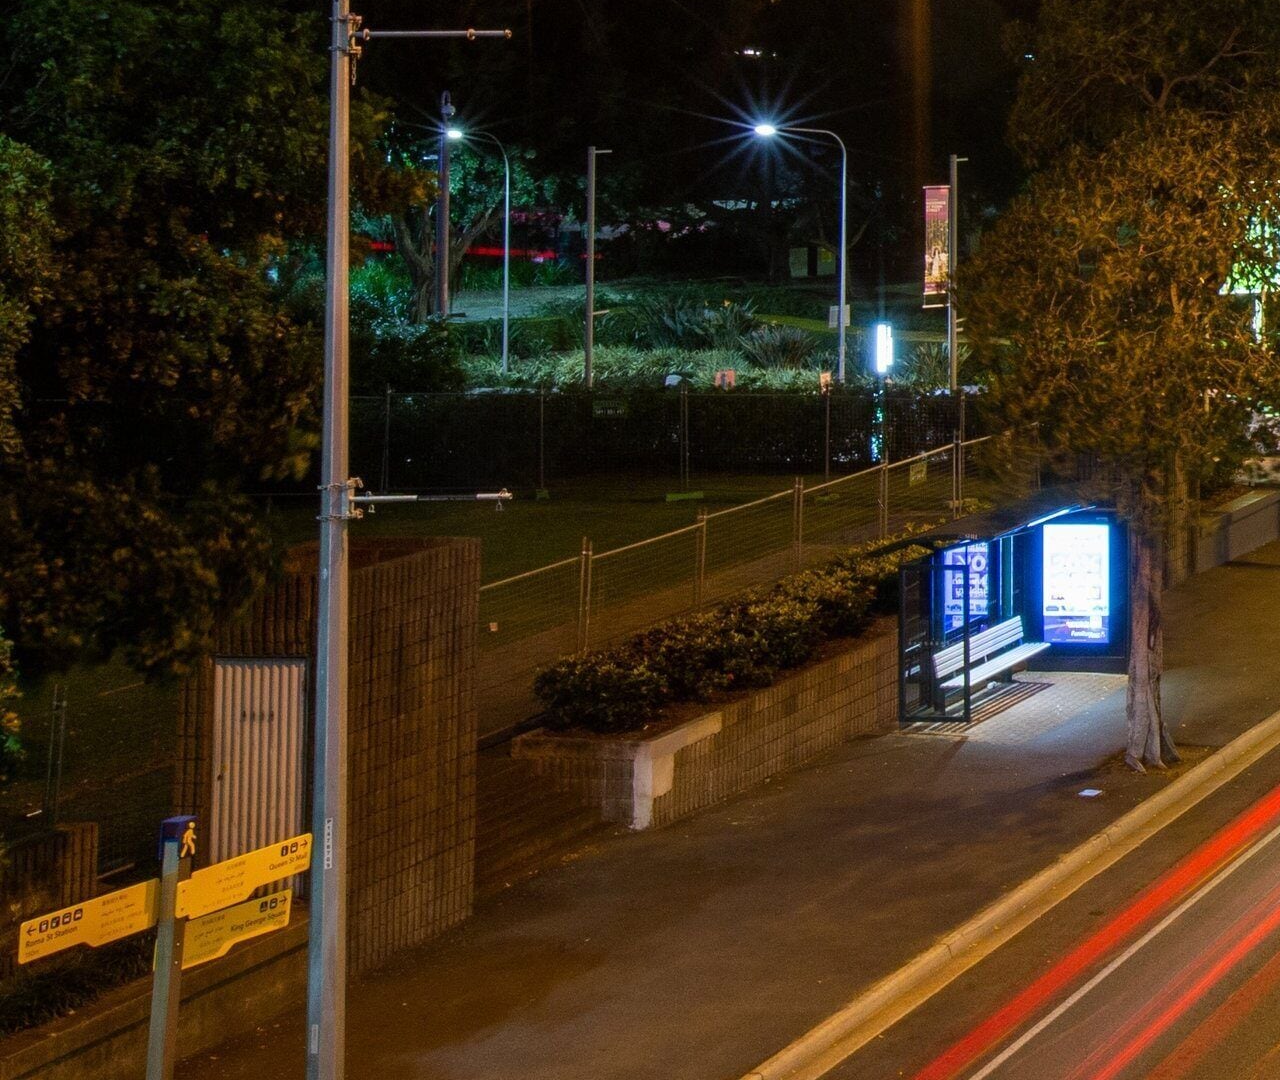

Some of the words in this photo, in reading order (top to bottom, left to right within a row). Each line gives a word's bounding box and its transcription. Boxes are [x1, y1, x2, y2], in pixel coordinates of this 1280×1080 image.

[269, 859, 288, 871] Queen
[231, 922, 245, 933] King
[245, 915, 266, 929] George
[25, 934, 45, 948] Roma
[54, 924, 78, 939] Station
